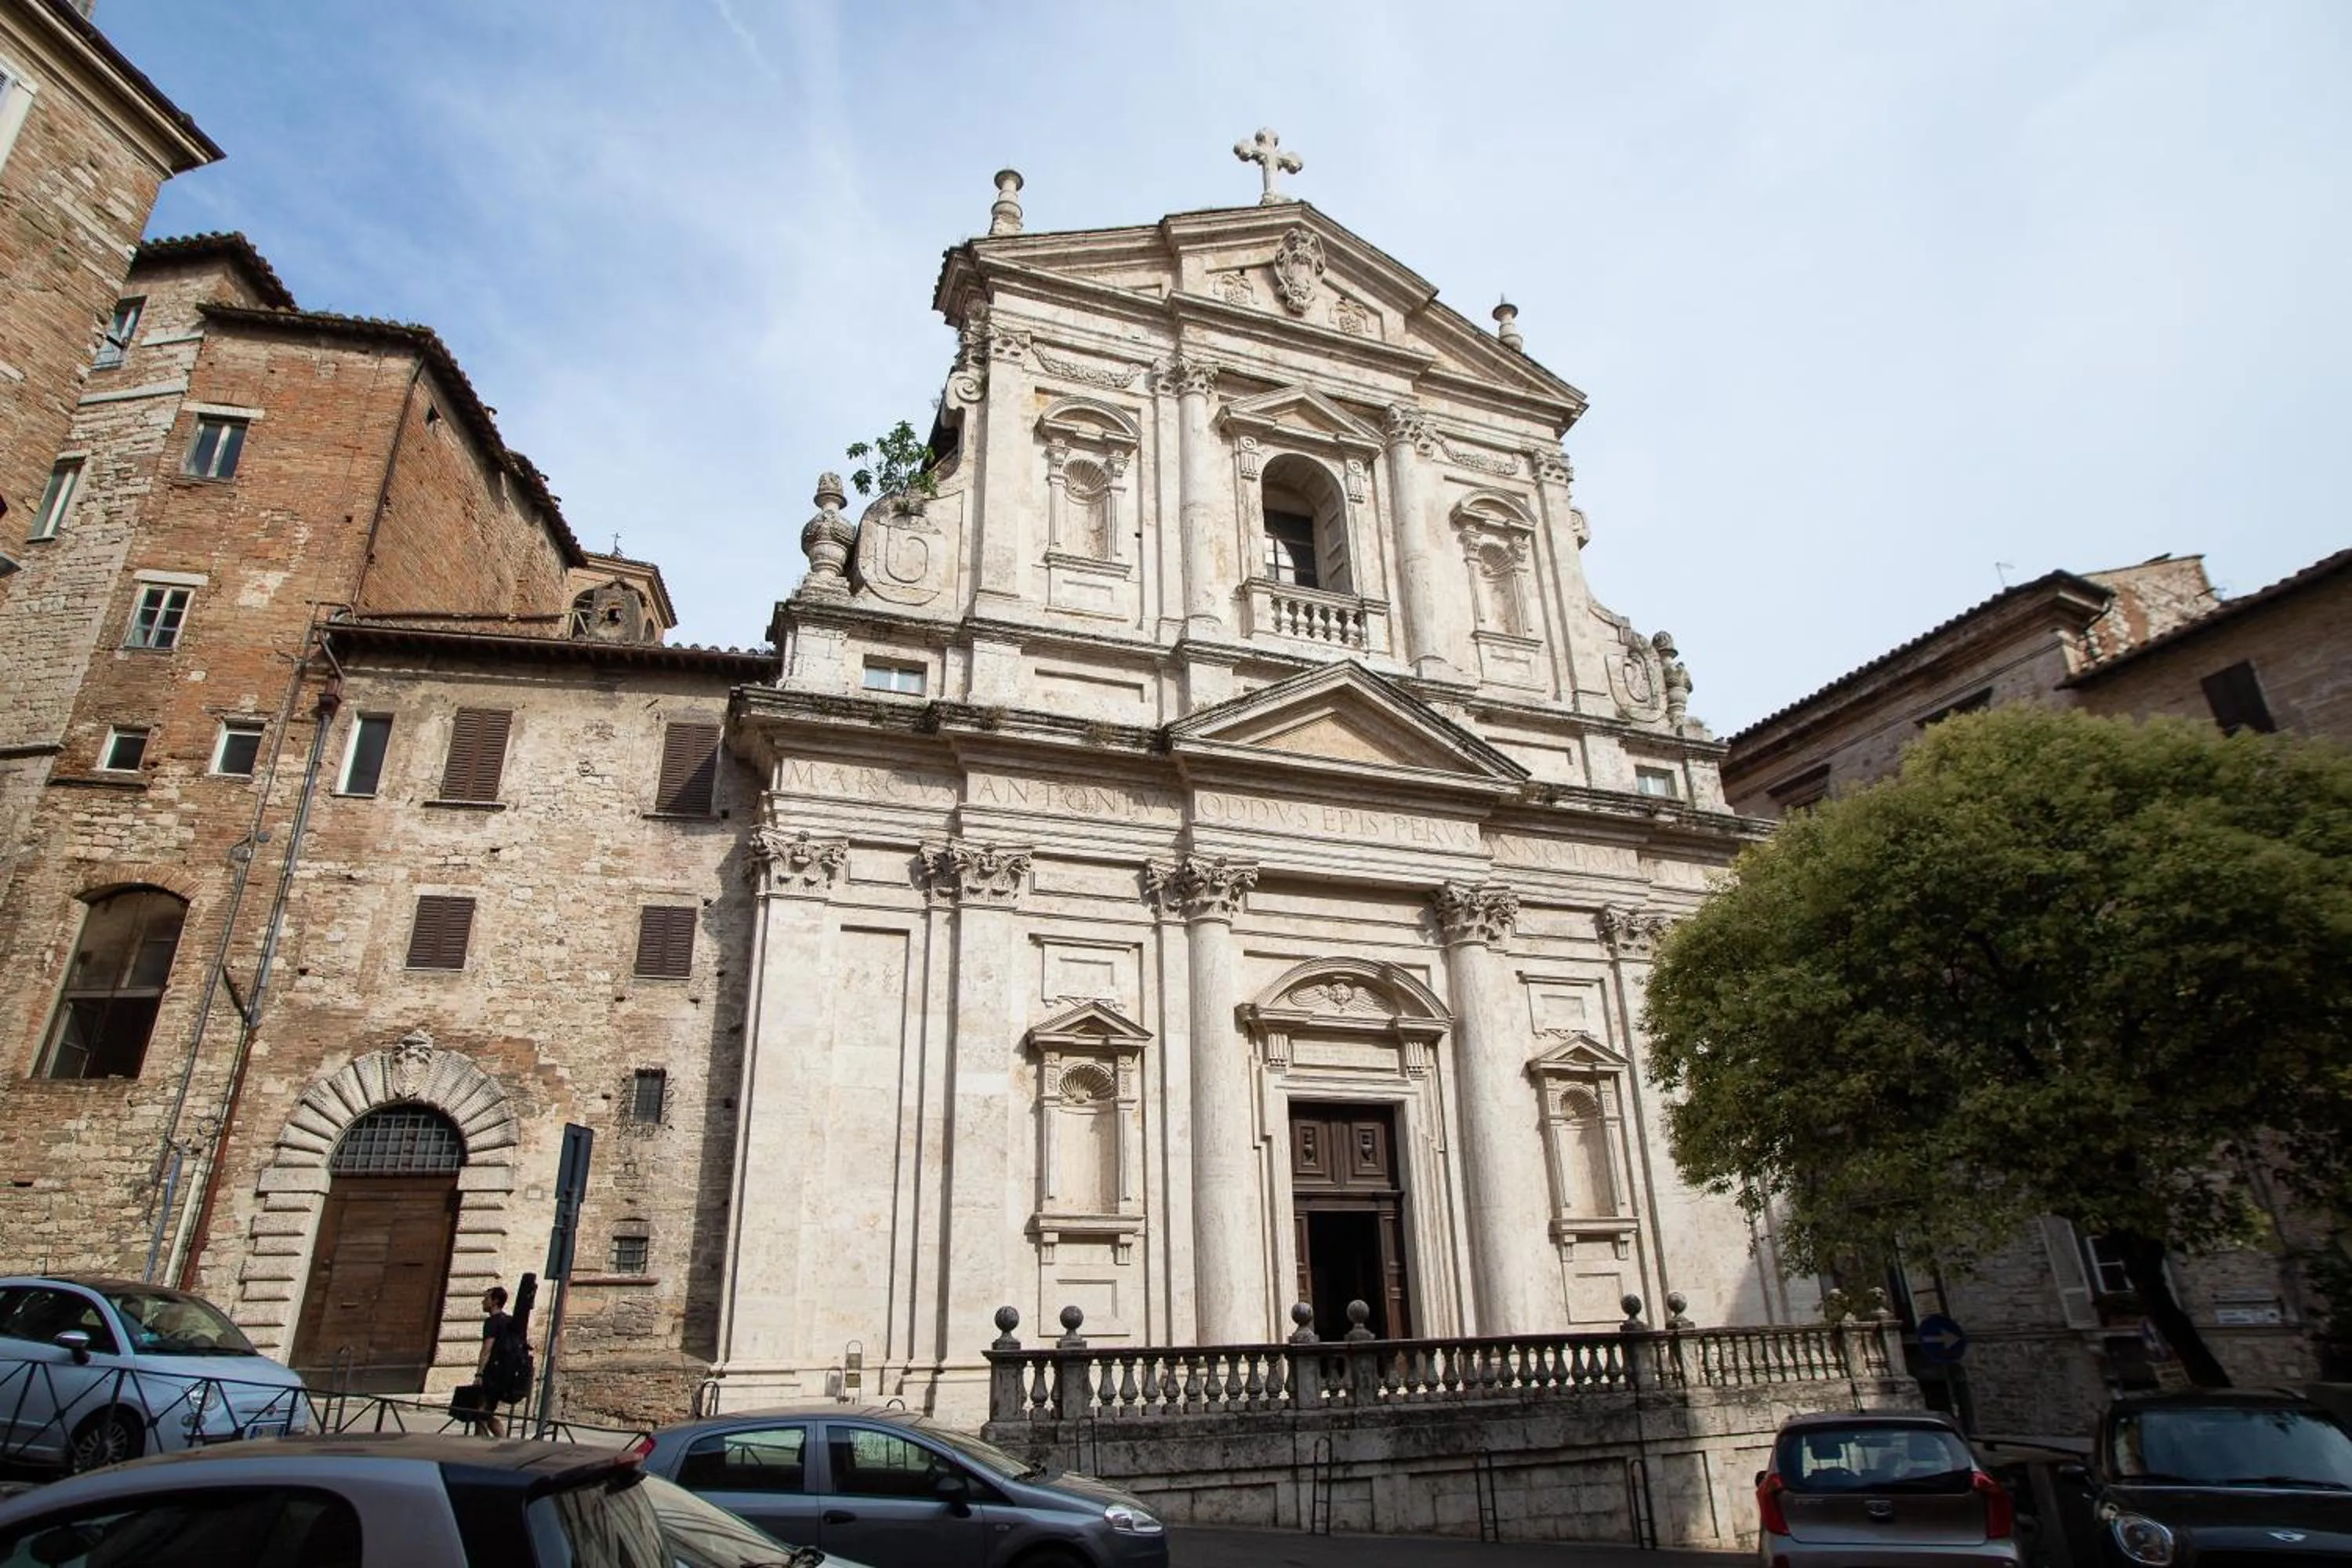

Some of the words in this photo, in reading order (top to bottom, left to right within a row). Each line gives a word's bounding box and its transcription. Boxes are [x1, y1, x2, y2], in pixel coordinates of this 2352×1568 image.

[786, 760, 956, 804] MARCVS
[978, 776, 1181, 821] ANTONIVS
[1199, 792, 1309, 829] ODDVS
